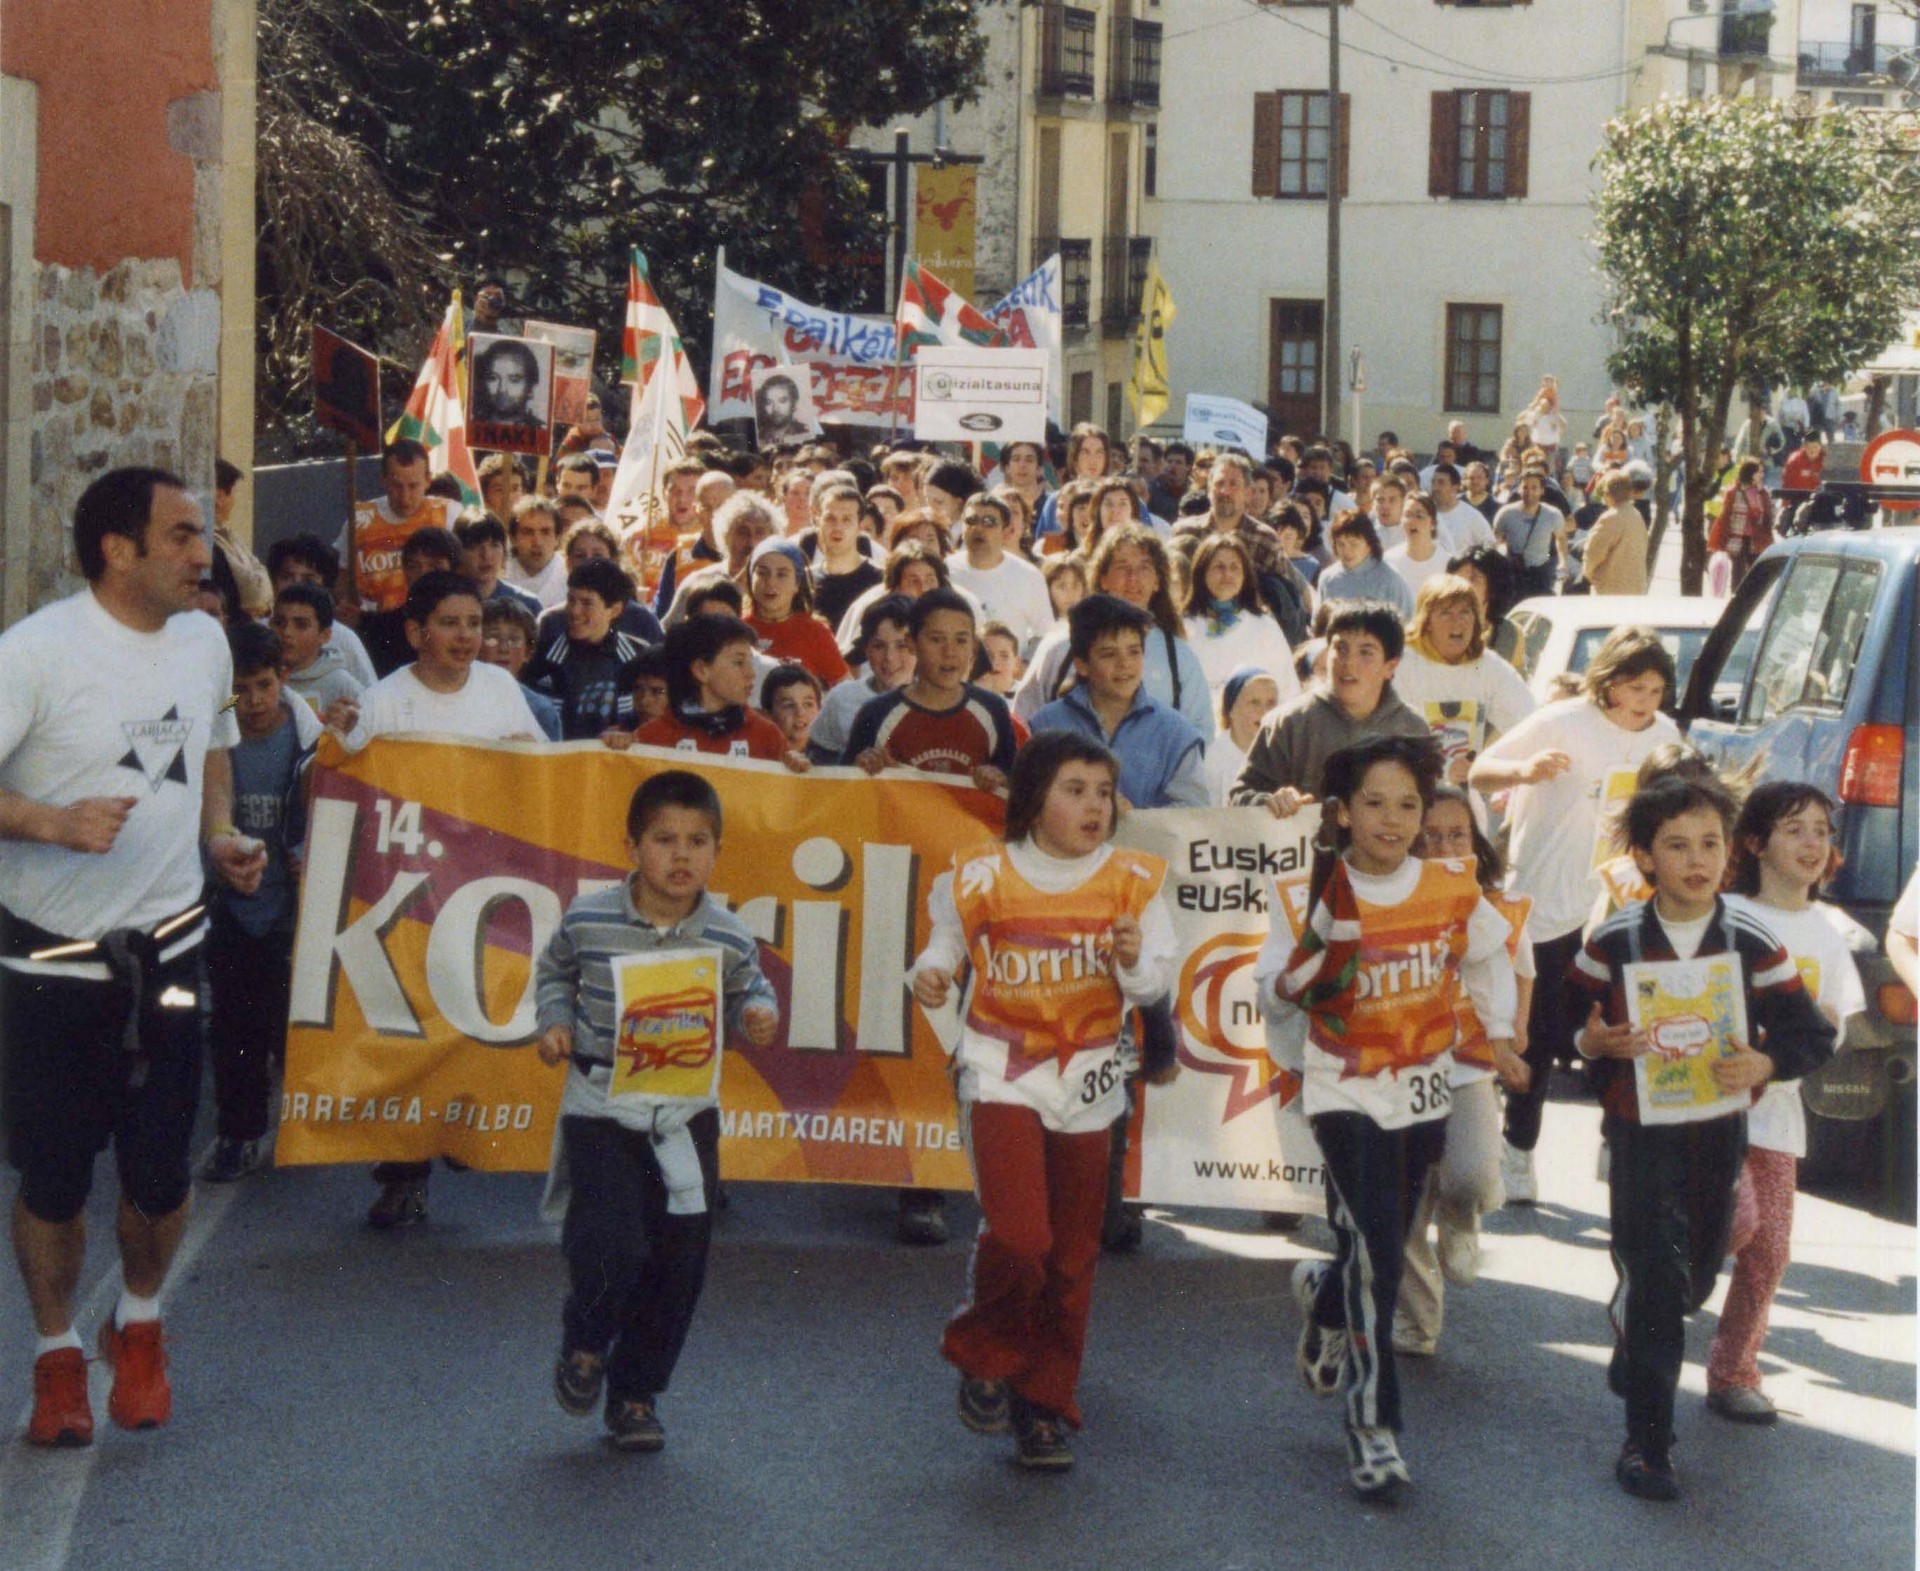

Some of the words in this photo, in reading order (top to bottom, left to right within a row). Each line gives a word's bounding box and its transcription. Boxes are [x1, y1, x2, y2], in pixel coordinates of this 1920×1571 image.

[758, 287, 898, 363] Epaiket
[374, 798, 444, 858] 14.
[1189, 836, 1306, 875] Euskal
[1081, 1060, 1120, 1104] 36
[1823, 1083, 1872, 1094] NISSAN
[720, 1110, 905, 1147] MARTXOAREN
